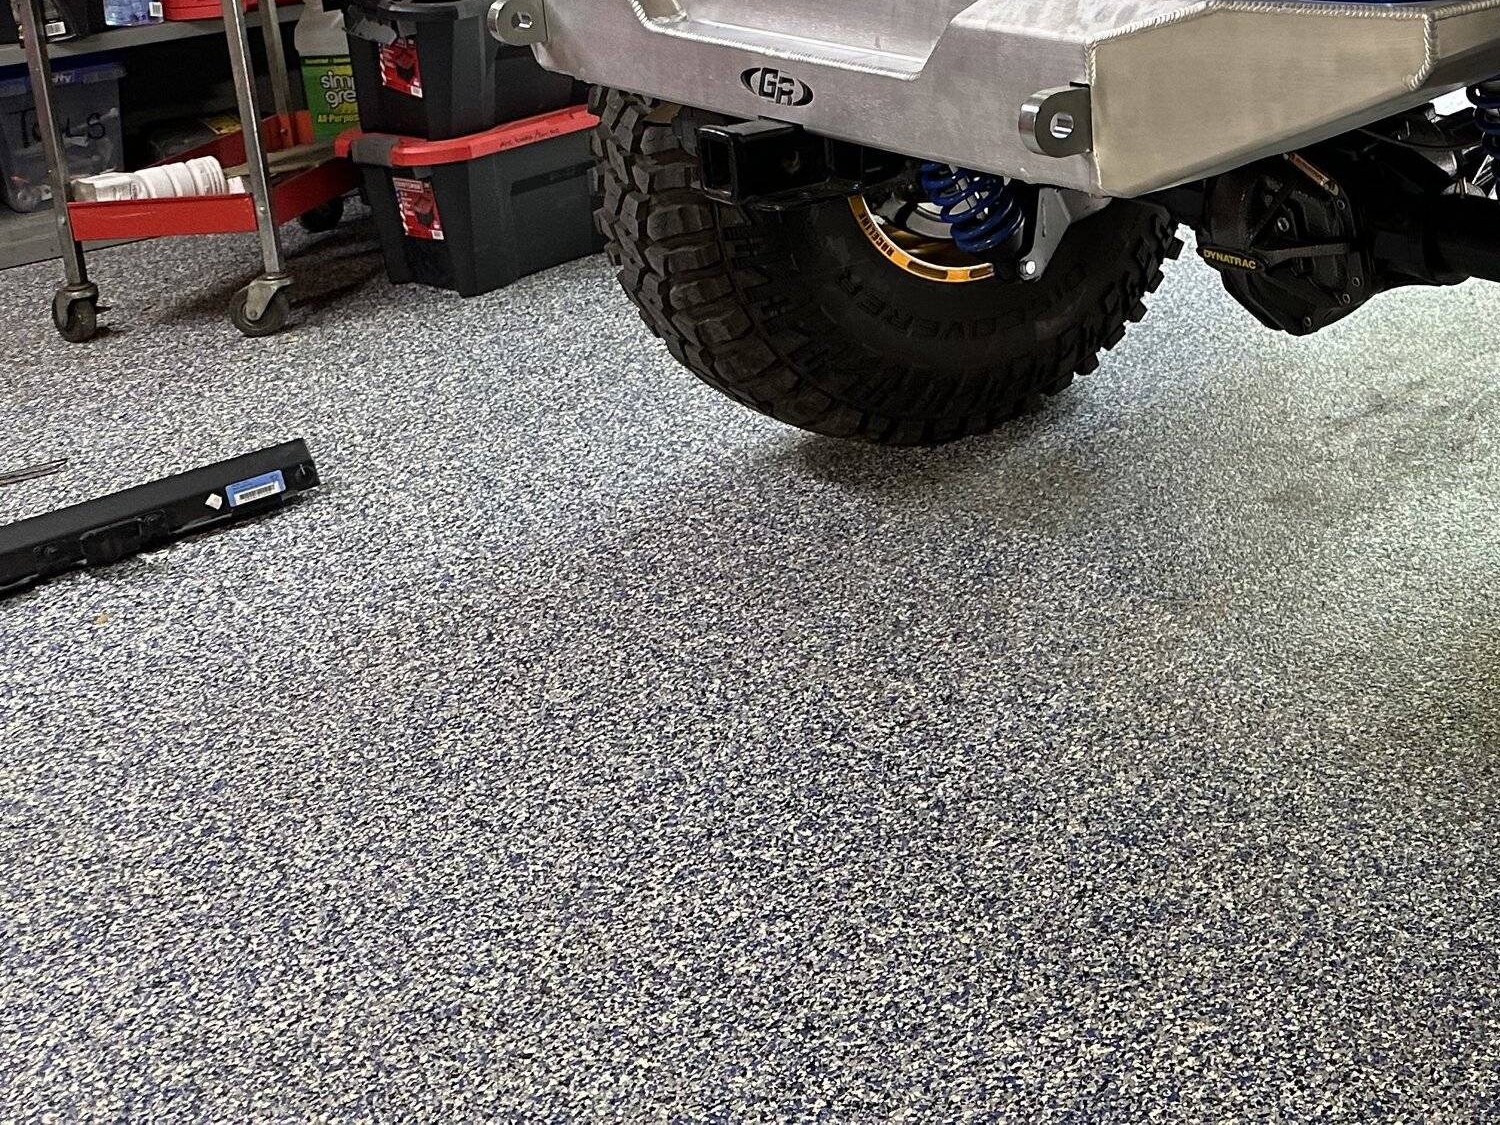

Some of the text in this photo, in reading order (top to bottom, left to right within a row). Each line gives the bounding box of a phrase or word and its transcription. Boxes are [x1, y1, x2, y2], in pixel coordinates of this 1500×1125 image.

[326, 88, 357, 108] gre
[758, 67, 795, 107] GR
[1203, 248, 1257, 271] DYNATRAC
